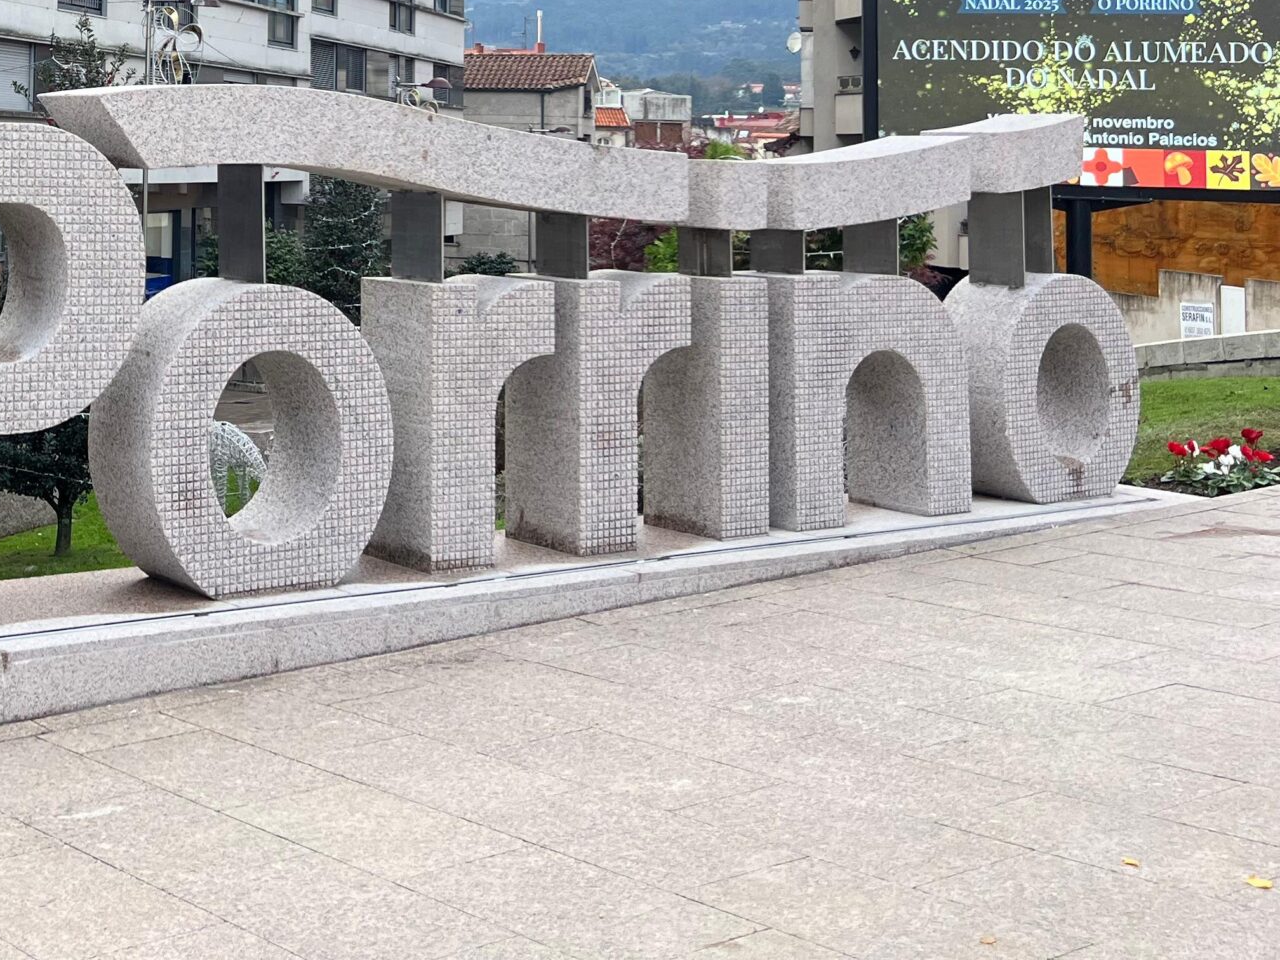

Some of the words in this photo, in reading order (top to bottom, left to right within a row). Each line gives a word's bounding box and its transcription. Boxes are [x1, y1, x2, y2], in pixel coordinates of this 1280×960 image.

[1023, 0, 1060, 12] 2025
[892, 39, 1045, 62] ACENDIDO
[1053, 40, 1096, 63] DO
[1103, 41, 1274, 64] ALUMEADO
[1004, 67, 1048, 90] DO
[1056, 68, 1156, 91] NADAL
[1092, 116, 1175, 130] novembro
[1083, 130, 1145, 146] Antonio
[1148, 132, 1218, 147] Palacios
[1181, 312, 1205, 322] SERAFIN
